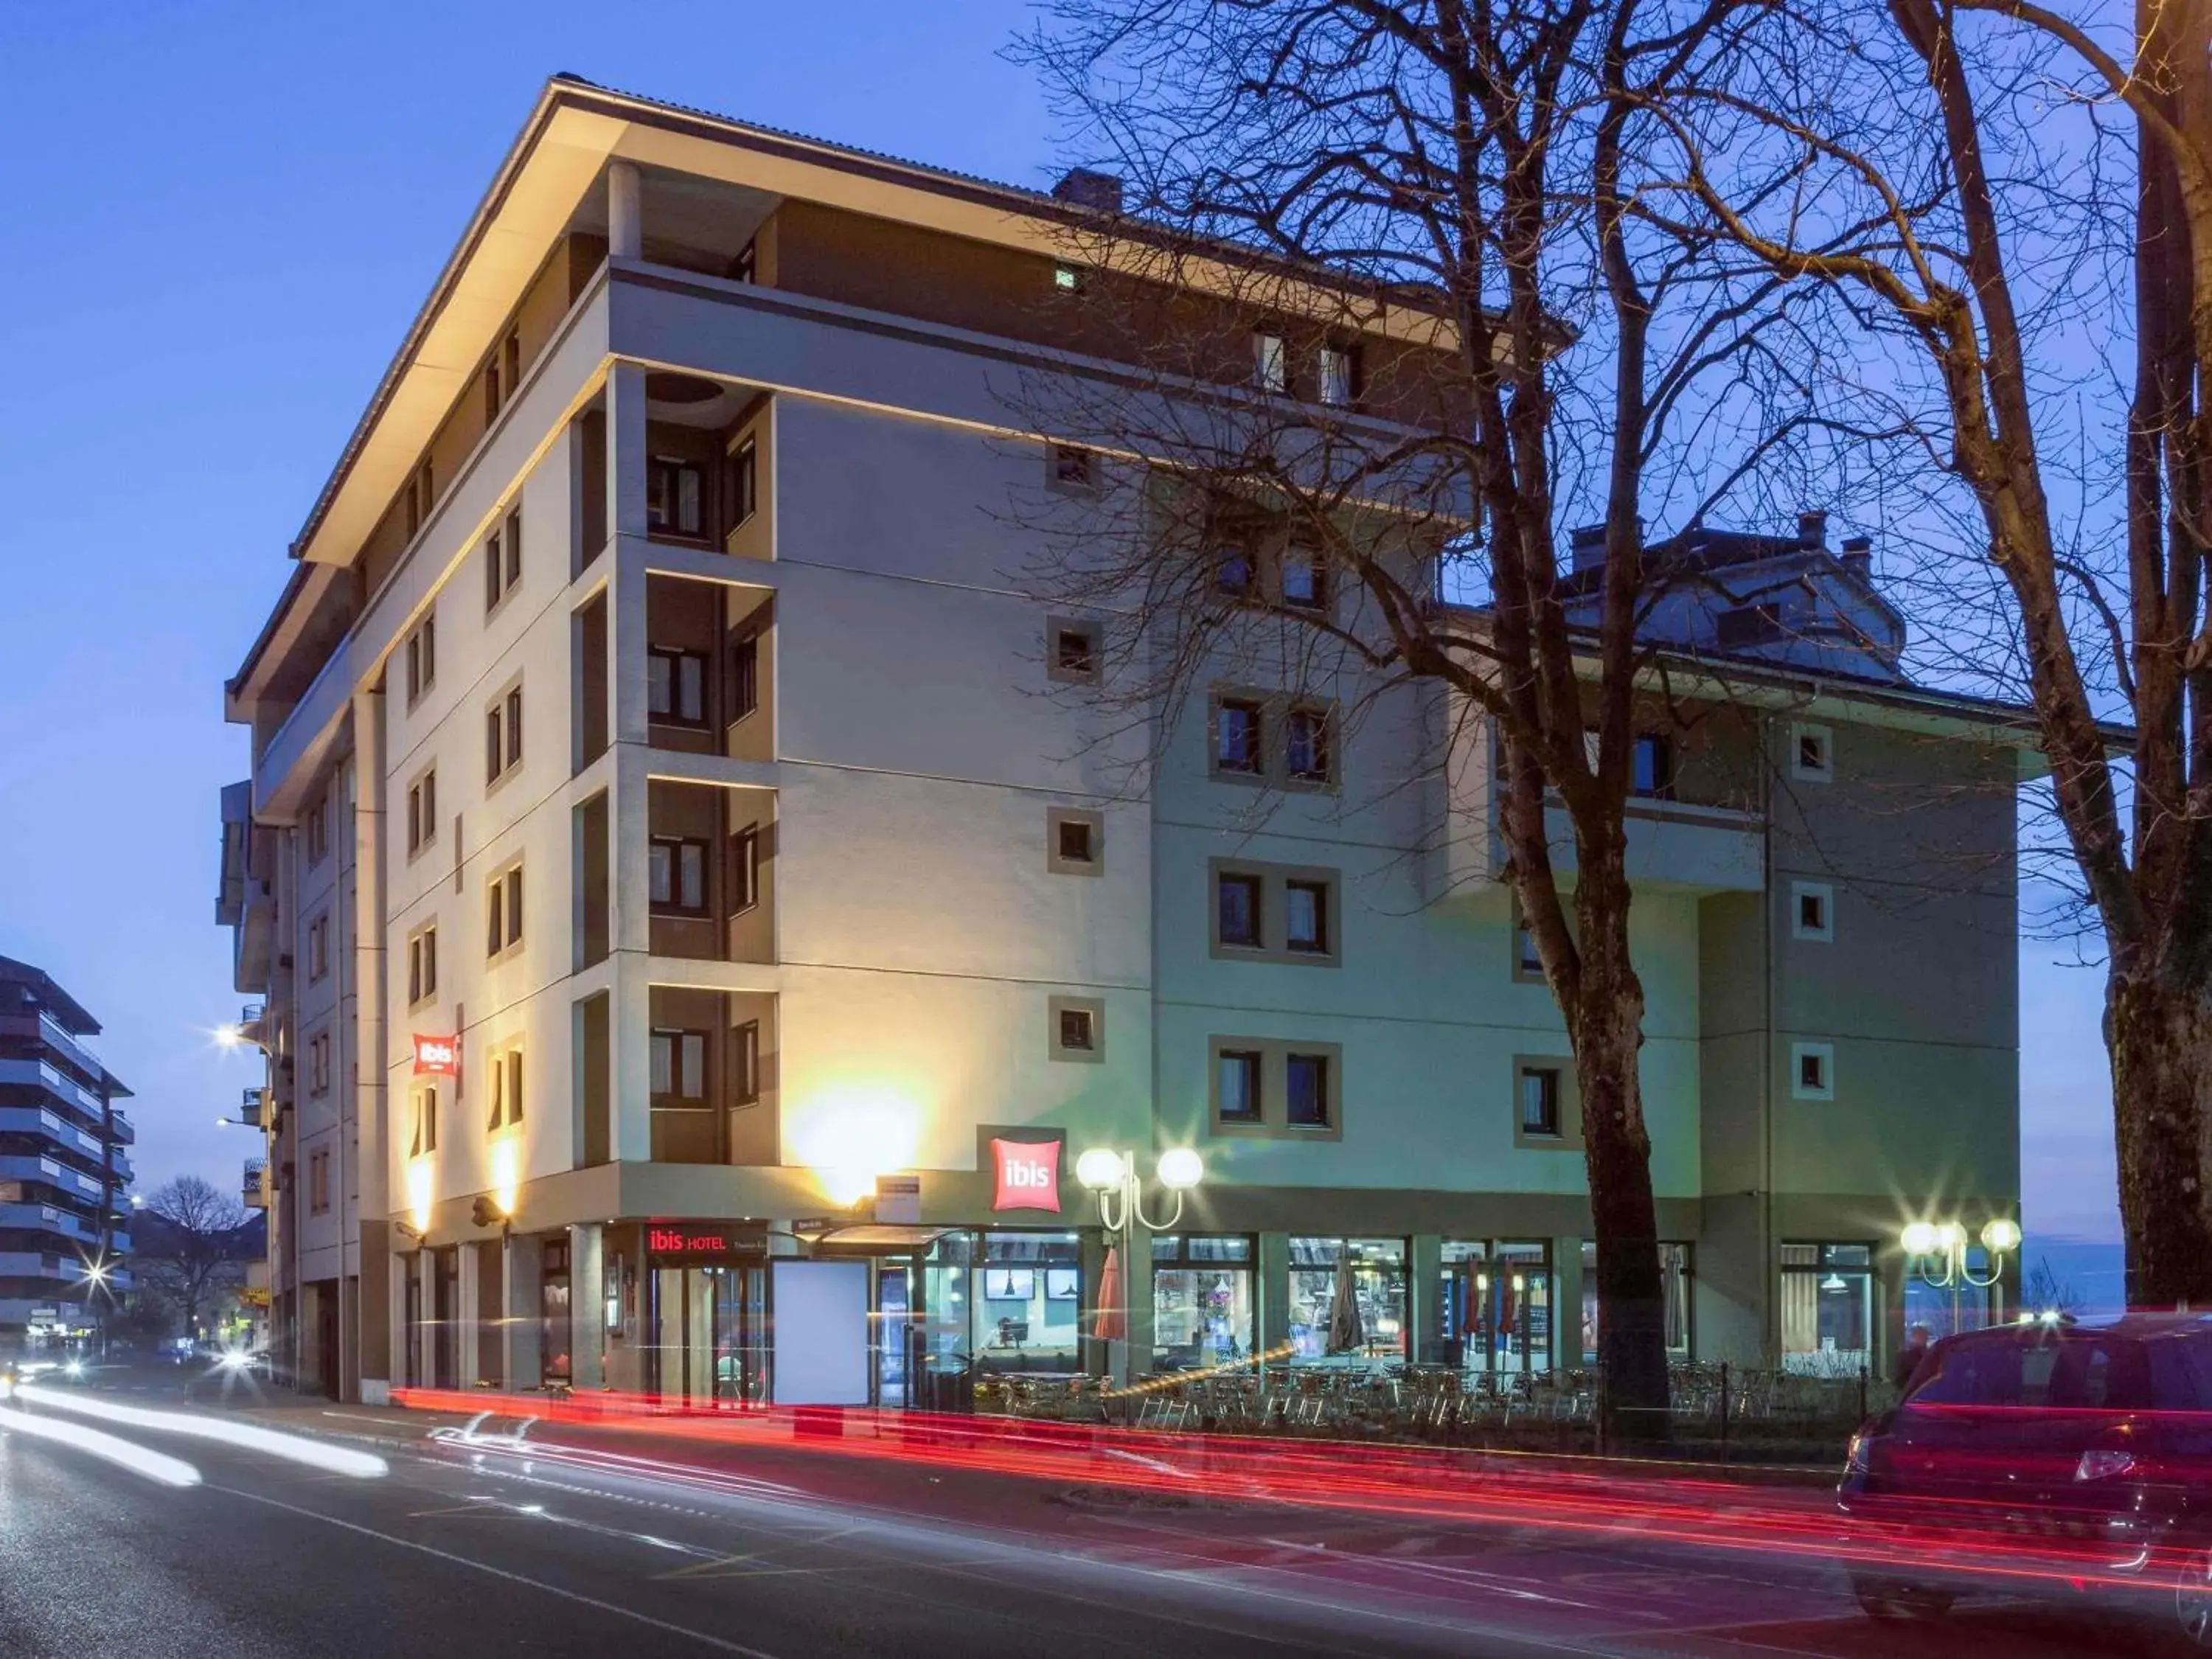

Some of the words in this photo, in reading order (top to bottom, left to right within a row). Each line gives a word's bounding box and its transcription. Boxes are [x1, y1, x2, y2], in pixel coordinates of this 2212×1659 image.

[420, 1043, 452, 1062] ibis
[1006, 1159, 1050, 1188] ibis
[650, 1230, 684, 1251] ibis
[687, 1237, 726, 1250] HOTEL
